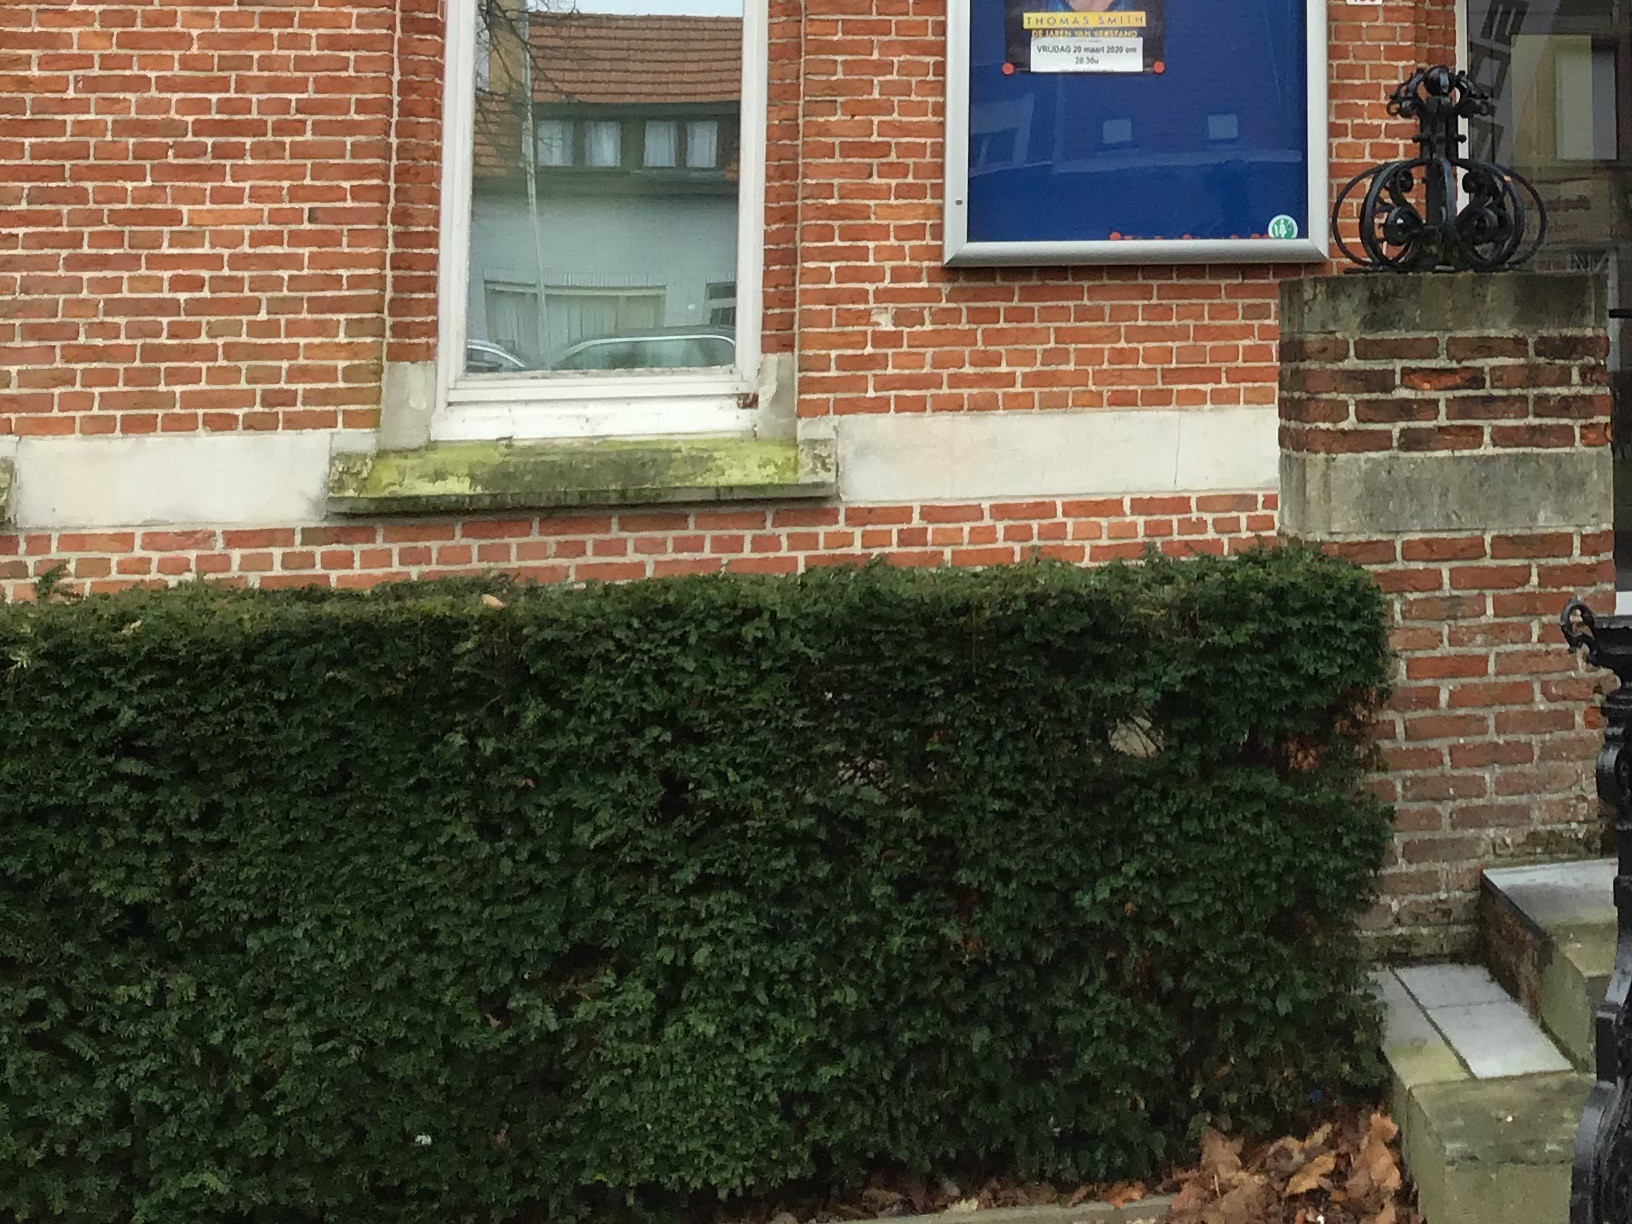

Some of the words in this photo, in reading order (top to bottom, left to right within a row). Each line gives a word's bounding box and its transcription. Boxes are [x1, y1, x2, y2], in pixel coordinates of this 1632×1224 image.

[1026, 15, 1089, 26] THOMAS
[1098, 15, 1144, 25] SMITH
[1036, 44, 1071, 54] VRIJDAG
[1073, 44, 1082, 53] 20
[1083, 44, 1104, 53] maart
[1106, 44, 1124, 53] 2020
